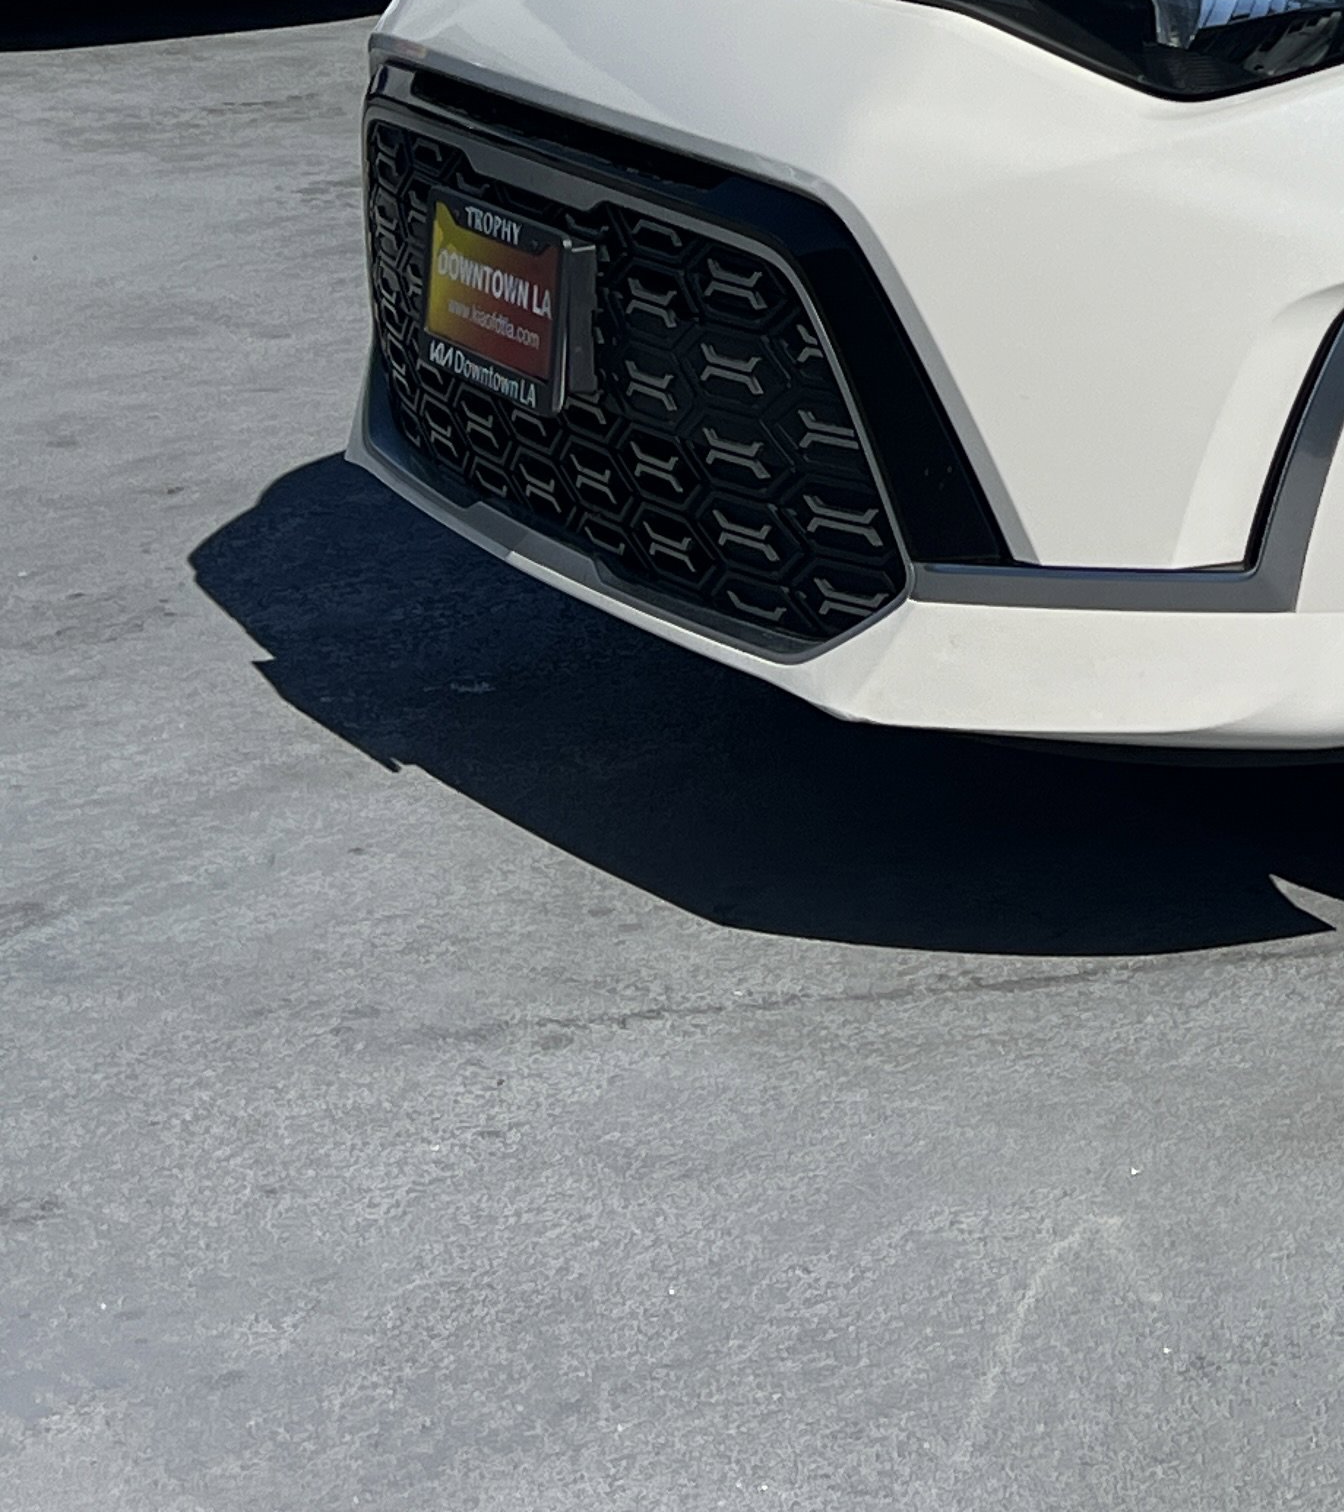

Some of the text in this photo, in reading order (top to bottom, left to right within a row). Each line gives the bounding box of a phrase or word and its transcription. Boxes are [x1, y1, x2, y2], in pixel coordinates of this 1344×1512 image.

[465, 206, 522, 245] TROPHY
[438, 248, 552, 320] DOWNTOWN LA
[454, 351, 518, 399] Downtown
[519, 378, 536, 408] LA
